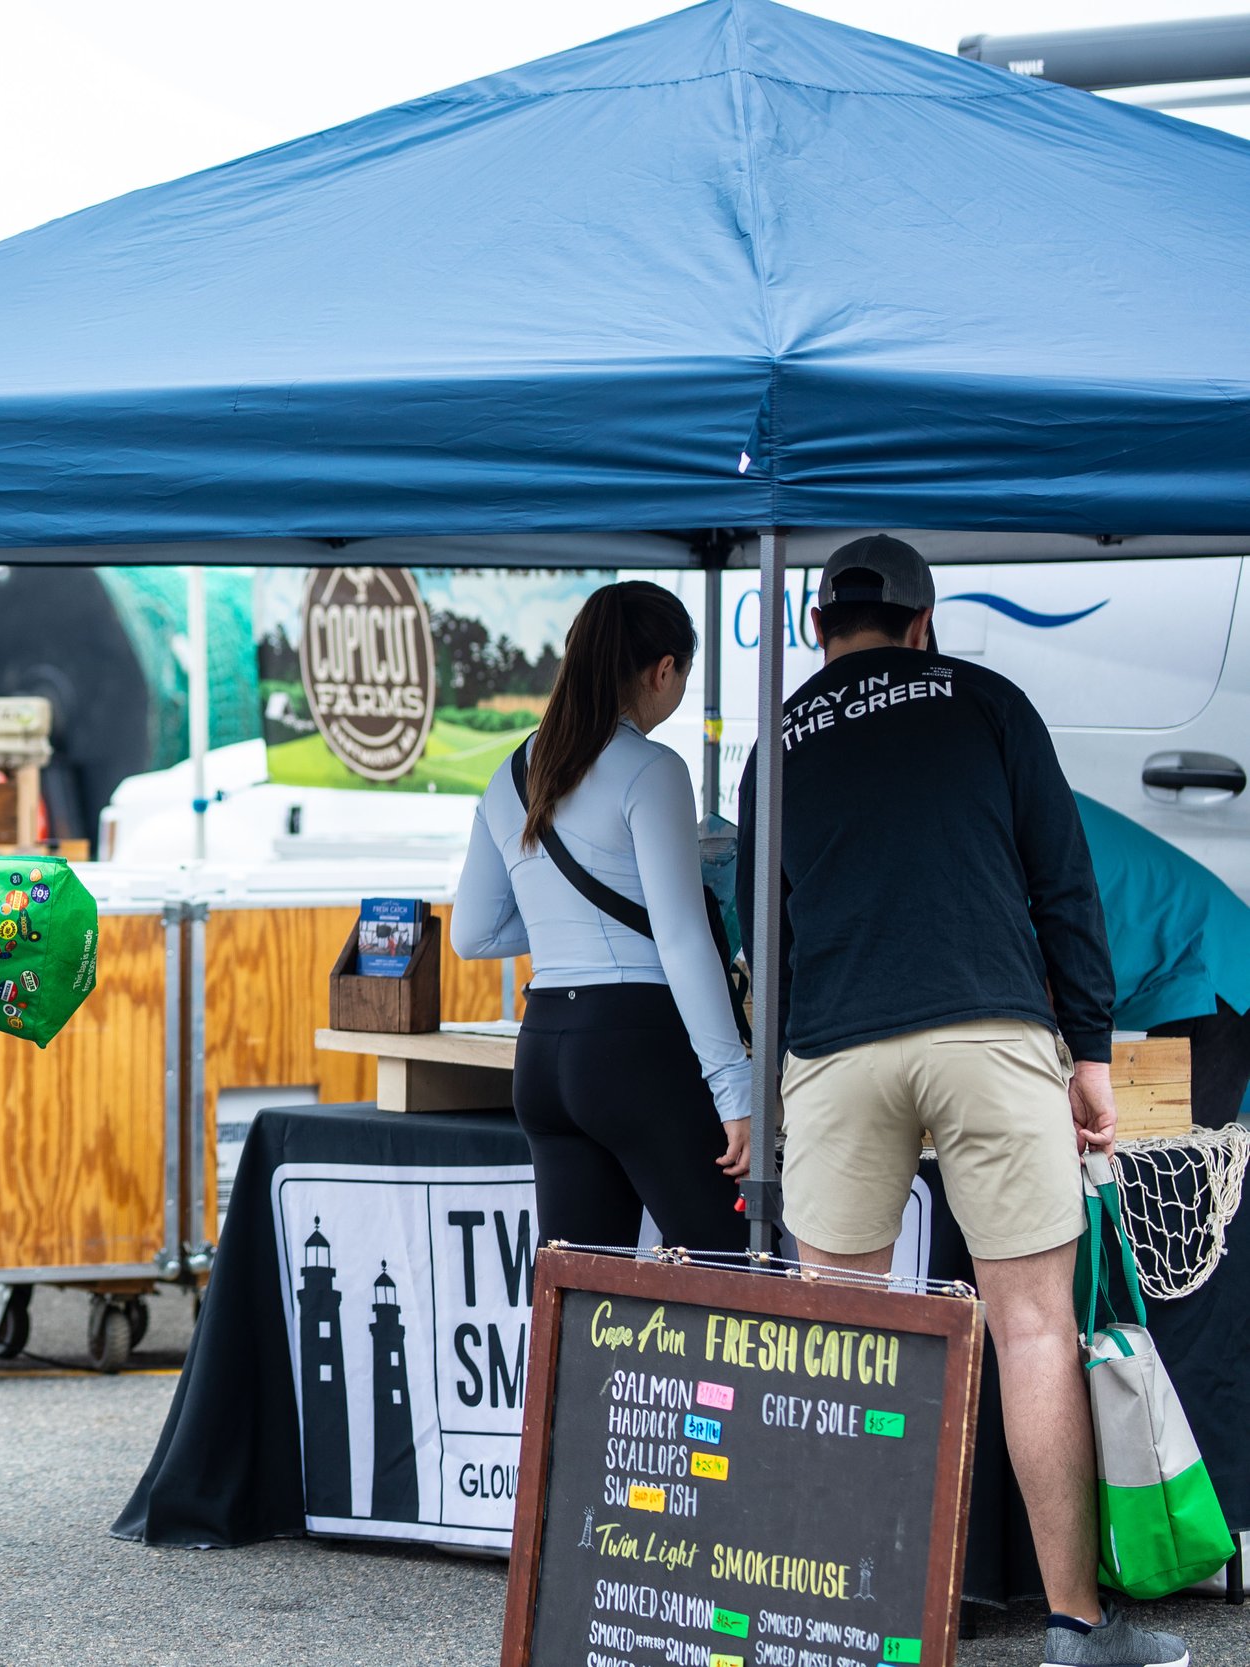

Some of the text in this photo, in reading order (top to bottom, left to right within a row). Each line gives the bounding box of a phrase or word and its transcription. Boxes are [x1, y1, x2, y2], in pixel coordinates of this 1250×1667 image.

[310, 604, 419, 684] COPICUT
[314, 683, 425, 719] FARMS
[782, 672, 889, 727] STAY IN
[782, 681, 953, 751] THE GREEN
[84, 930, 93, 952] made
[73, 974, 84, 989] This
[77, 960, 89, 973] bag
[82, 975, 93, 991] from
[591, 1300, 899, 1387] Cape Ann FRESH CATCH
[612, 1370, 693, 1410] SALMON
[608, 1405, 679, 1440] HADDOCK
[762, 1393, 862, 1437] GREY SOLE
[605, 1437, 688, 1478] SCALLOPS
[595, 1523, 850, 1600] Twin Light SMOKEHOUSE
[594, 1579, 715, 1630] SMOKED SALMON
[589, 1620, 711, 1667] SMOKED PEPPERED SALMON
[757, 1609, 879, 1651] SMOKED SALMON SPREAD
[755, 1640, 796, 1667] SMOKED
